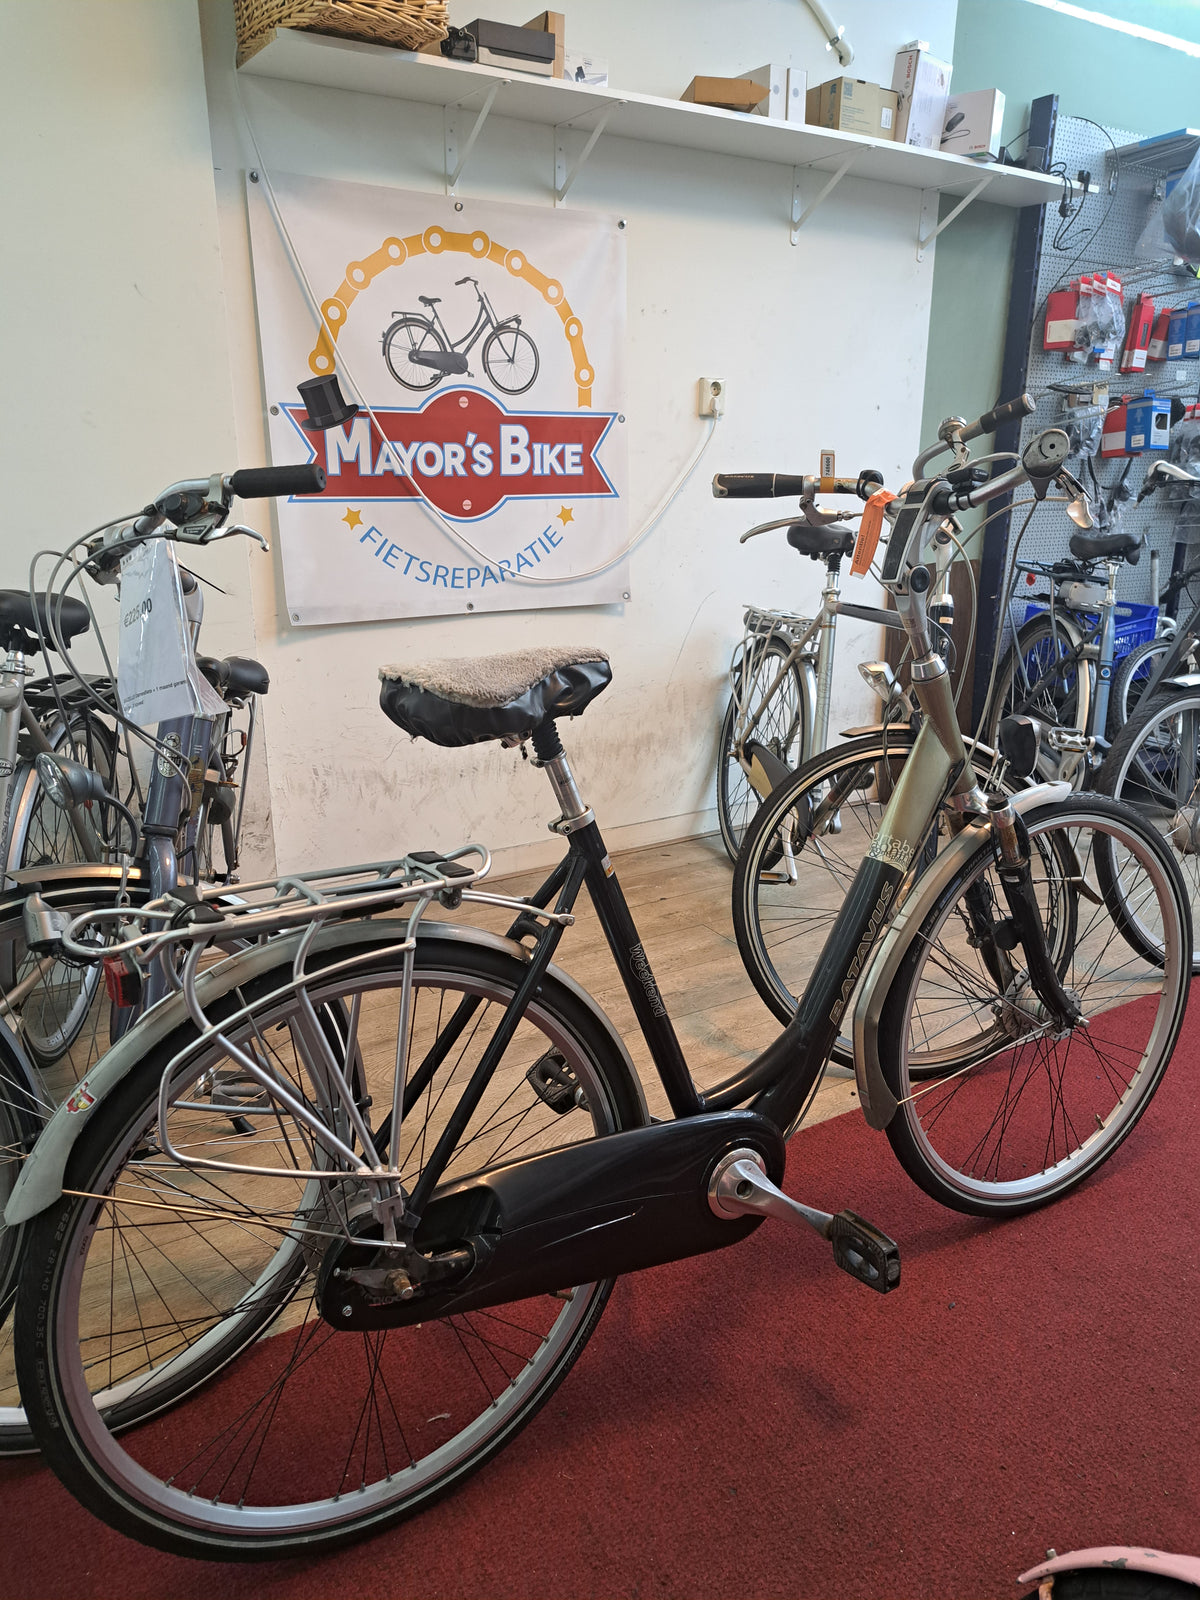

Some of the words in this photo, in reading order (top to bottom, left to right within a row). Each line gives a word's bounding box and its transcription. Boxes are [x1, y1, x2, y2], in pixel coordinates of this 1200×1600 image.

[323, 416, 494, 477] MAYOR'S
[500, 423, 584, 477] BIKE
[359, 524, 564, 589] FIETSREPARATIE
[629, 942, 667, 1018] Weekend
[829, 880, 894, 1025] BATAVUS
